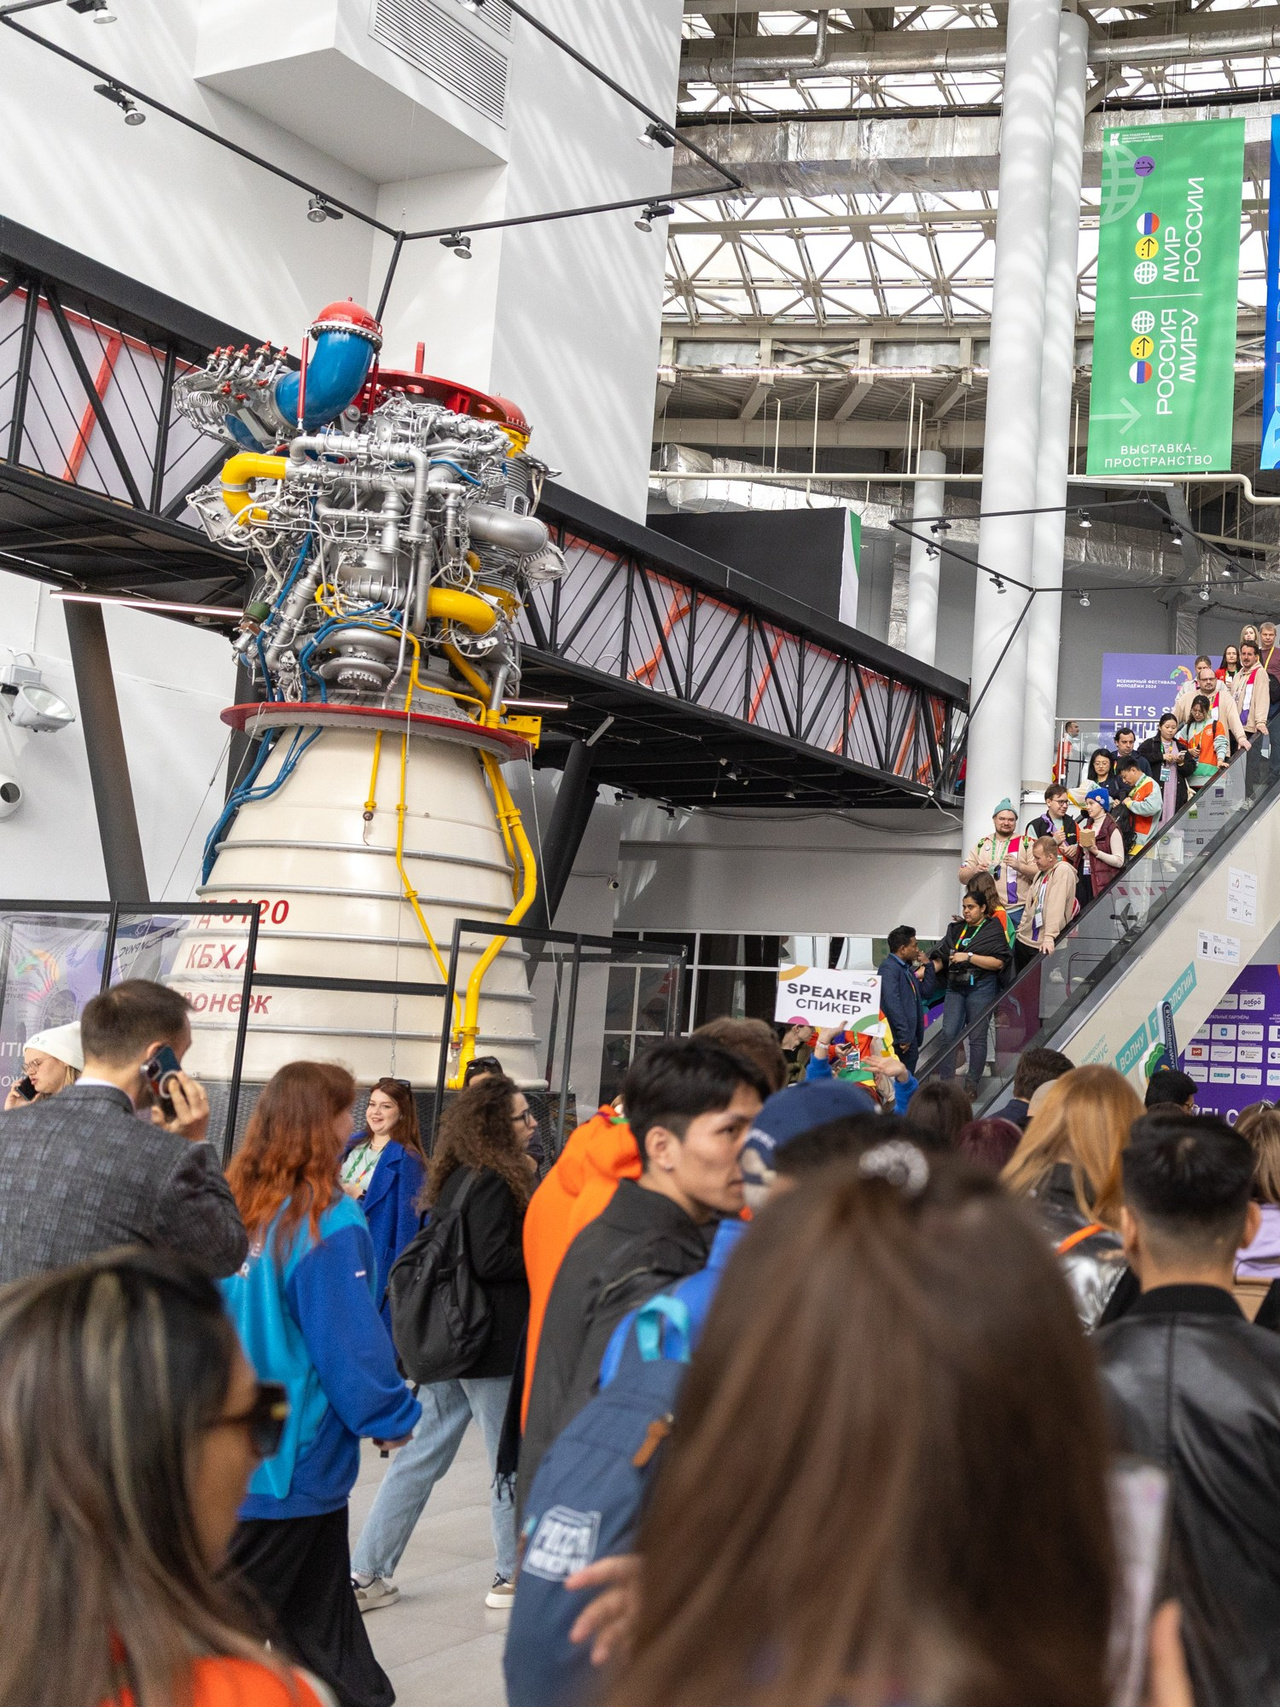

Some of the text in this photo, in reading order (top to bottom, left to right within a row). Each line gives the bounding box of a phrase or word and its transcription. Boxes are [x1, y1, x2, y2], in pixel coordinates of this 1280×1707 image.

[1184, 177, 1204, 283] РОССИИ
[1163, 225, 1181, 283] МИР
[1157, 308, 1178, 415] РОССИЯ
[1179, 308, 1199, 384] МИРУ
[1104, 454, 1213, 468] ПРОСТРАНСТВО
[1120, 443, 1197, 456] ВЫСТАВКА-
[787, 982, 872, 1004] SPEAKER
[796, 998, 862, 1015] СПИКЕР
[1120, 1032, 1145, 1071] ВОЛНУ
